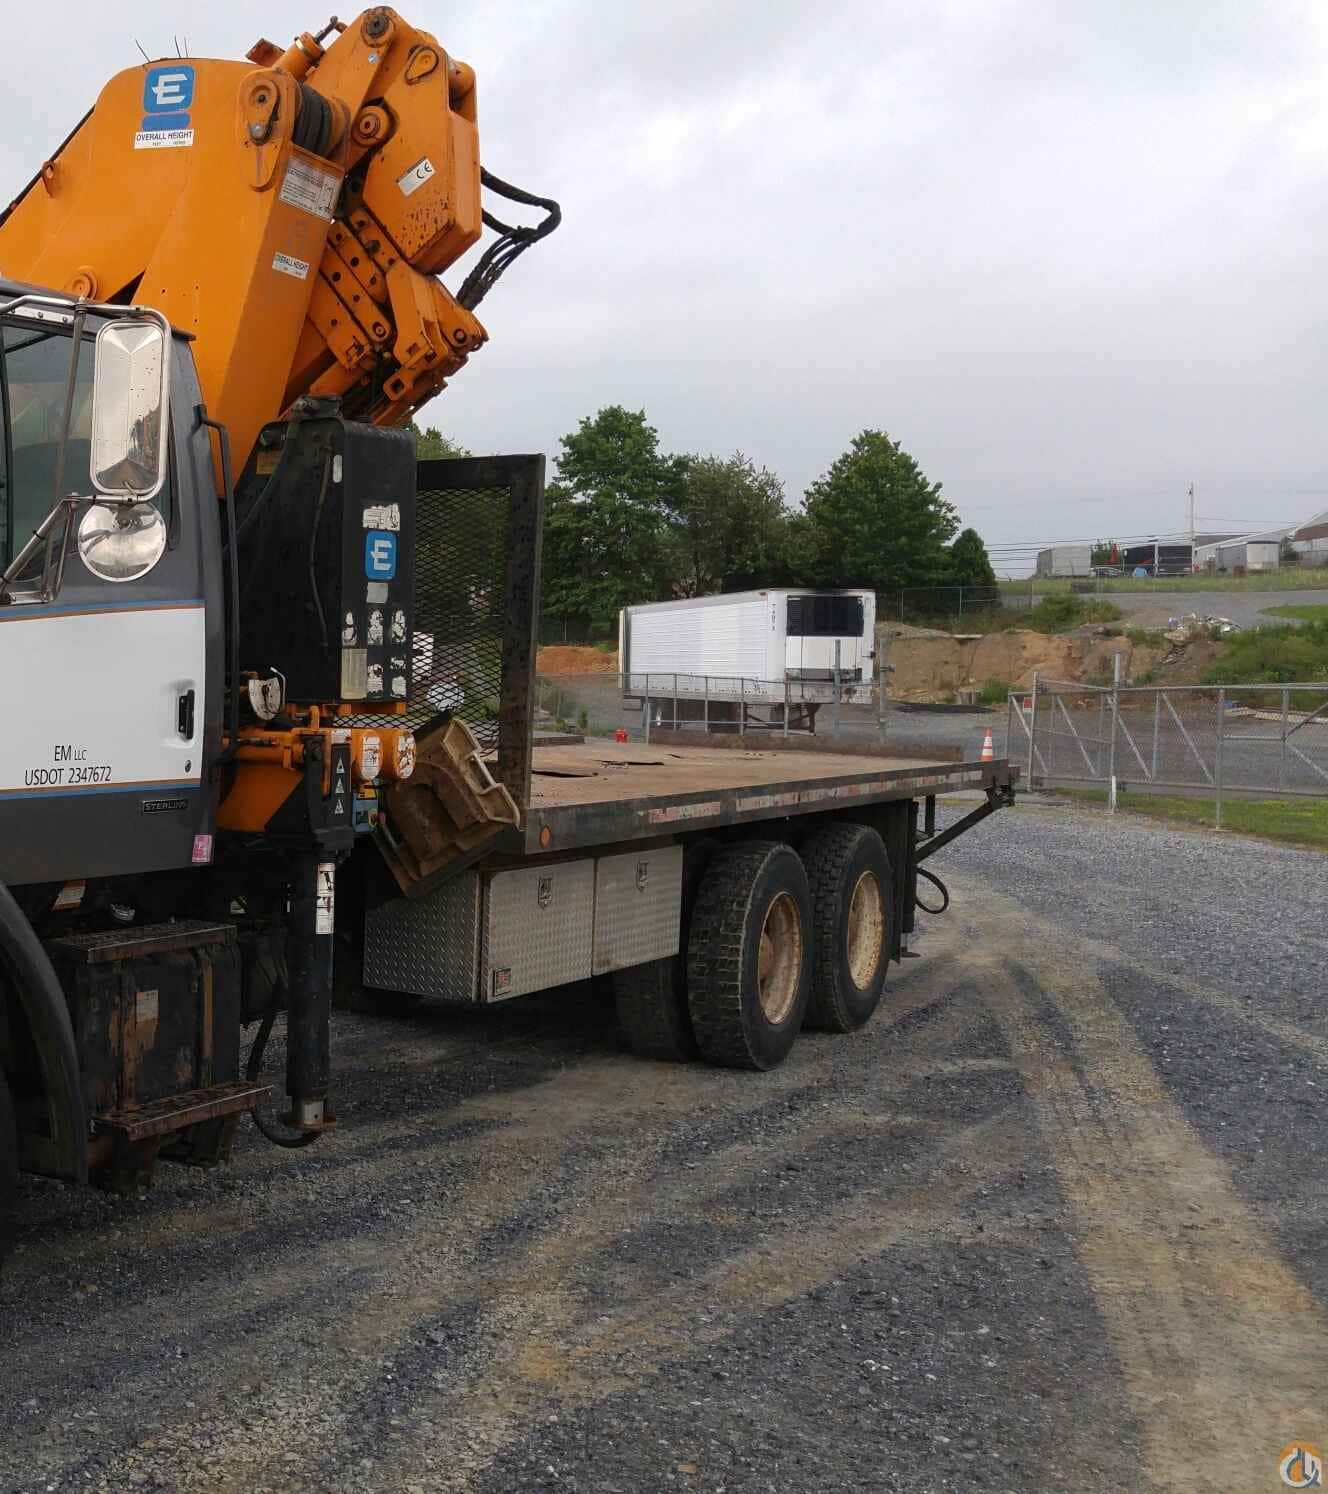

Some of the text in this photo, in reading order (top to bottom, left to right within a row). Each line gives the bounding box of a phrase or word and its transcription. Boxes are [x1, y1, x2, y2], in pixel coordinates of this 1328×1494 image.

[152, 74, 188, 105] E
[136, 131, 192, 141] OVERALL HEIGHT
[371, 540, 392, 571] E
[54, 745, 88, 761] EM LLC
[25, 765, 112, 785] USDOT 2347672
